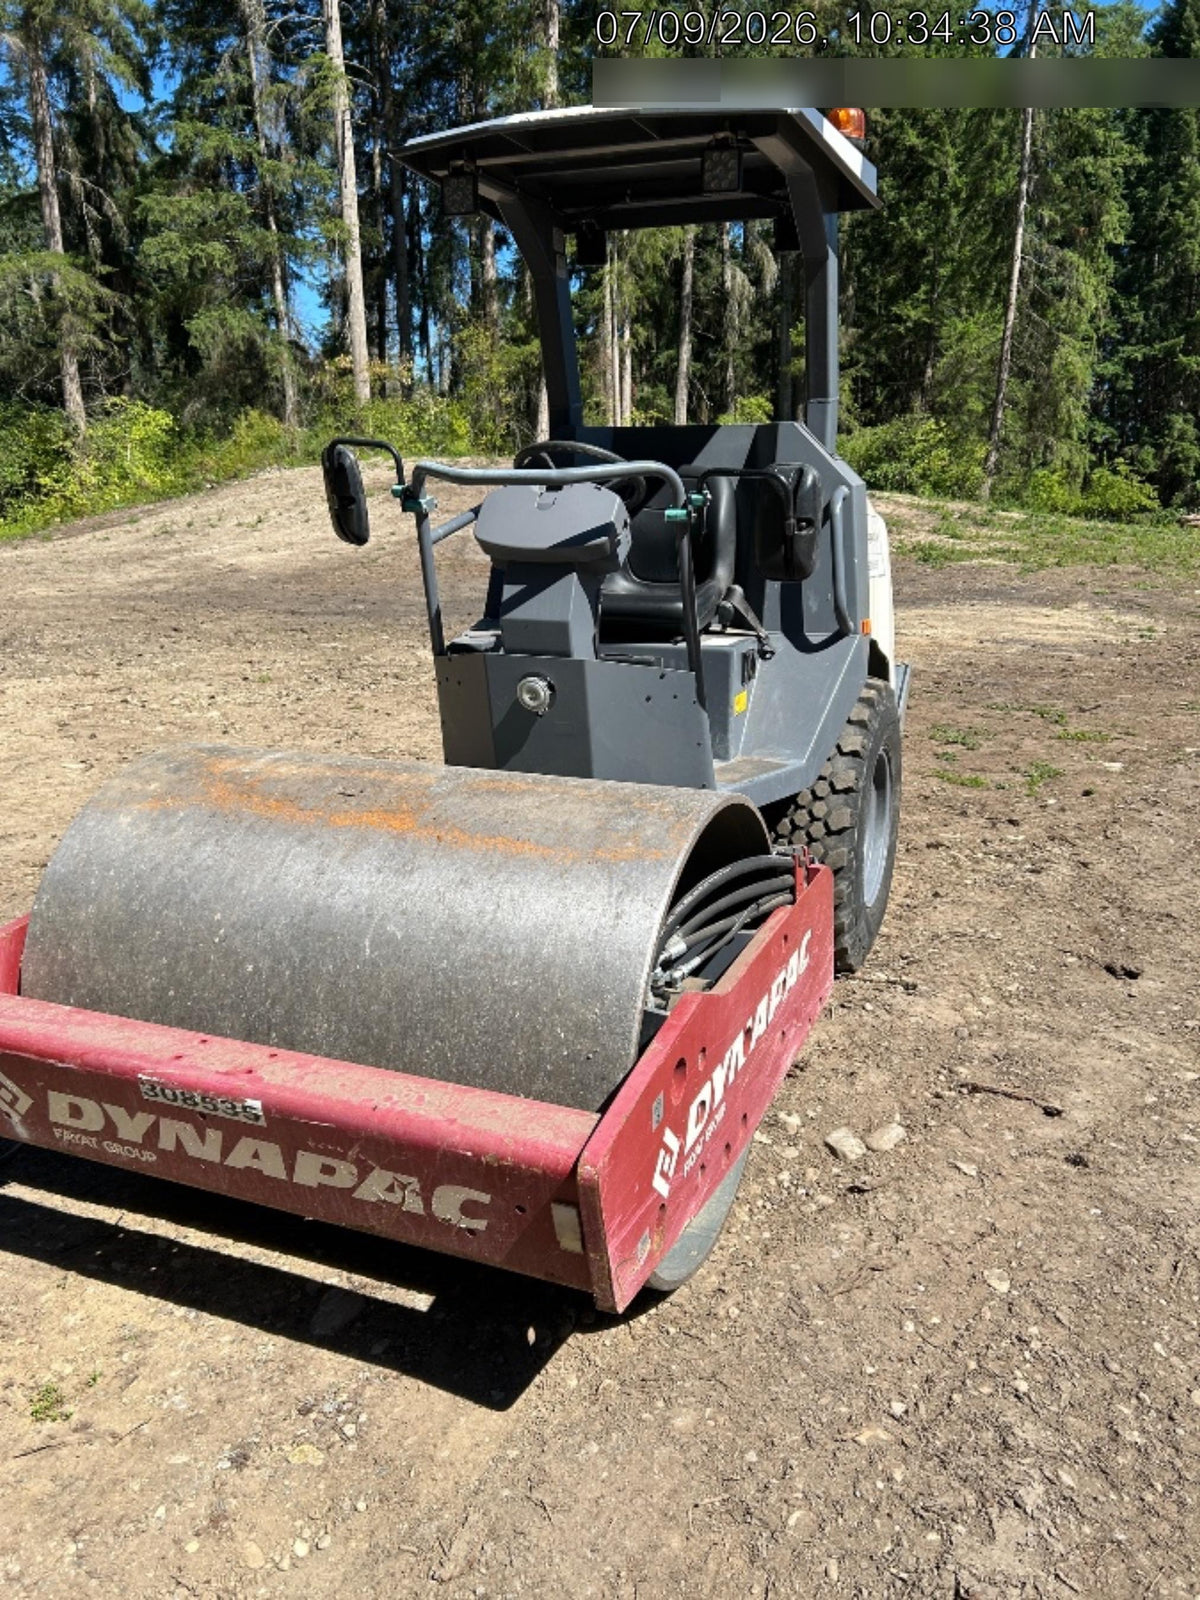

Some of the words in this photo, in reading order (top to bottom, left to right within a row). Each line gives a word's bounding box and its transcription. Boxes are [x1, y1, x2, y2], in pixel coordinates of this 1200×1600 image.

[684, 929, 812, 1156] DYNAPAC
[47, 1089, 492, 1232] DYNAPAC
[103, 1140, 157, 1163] GROUP
